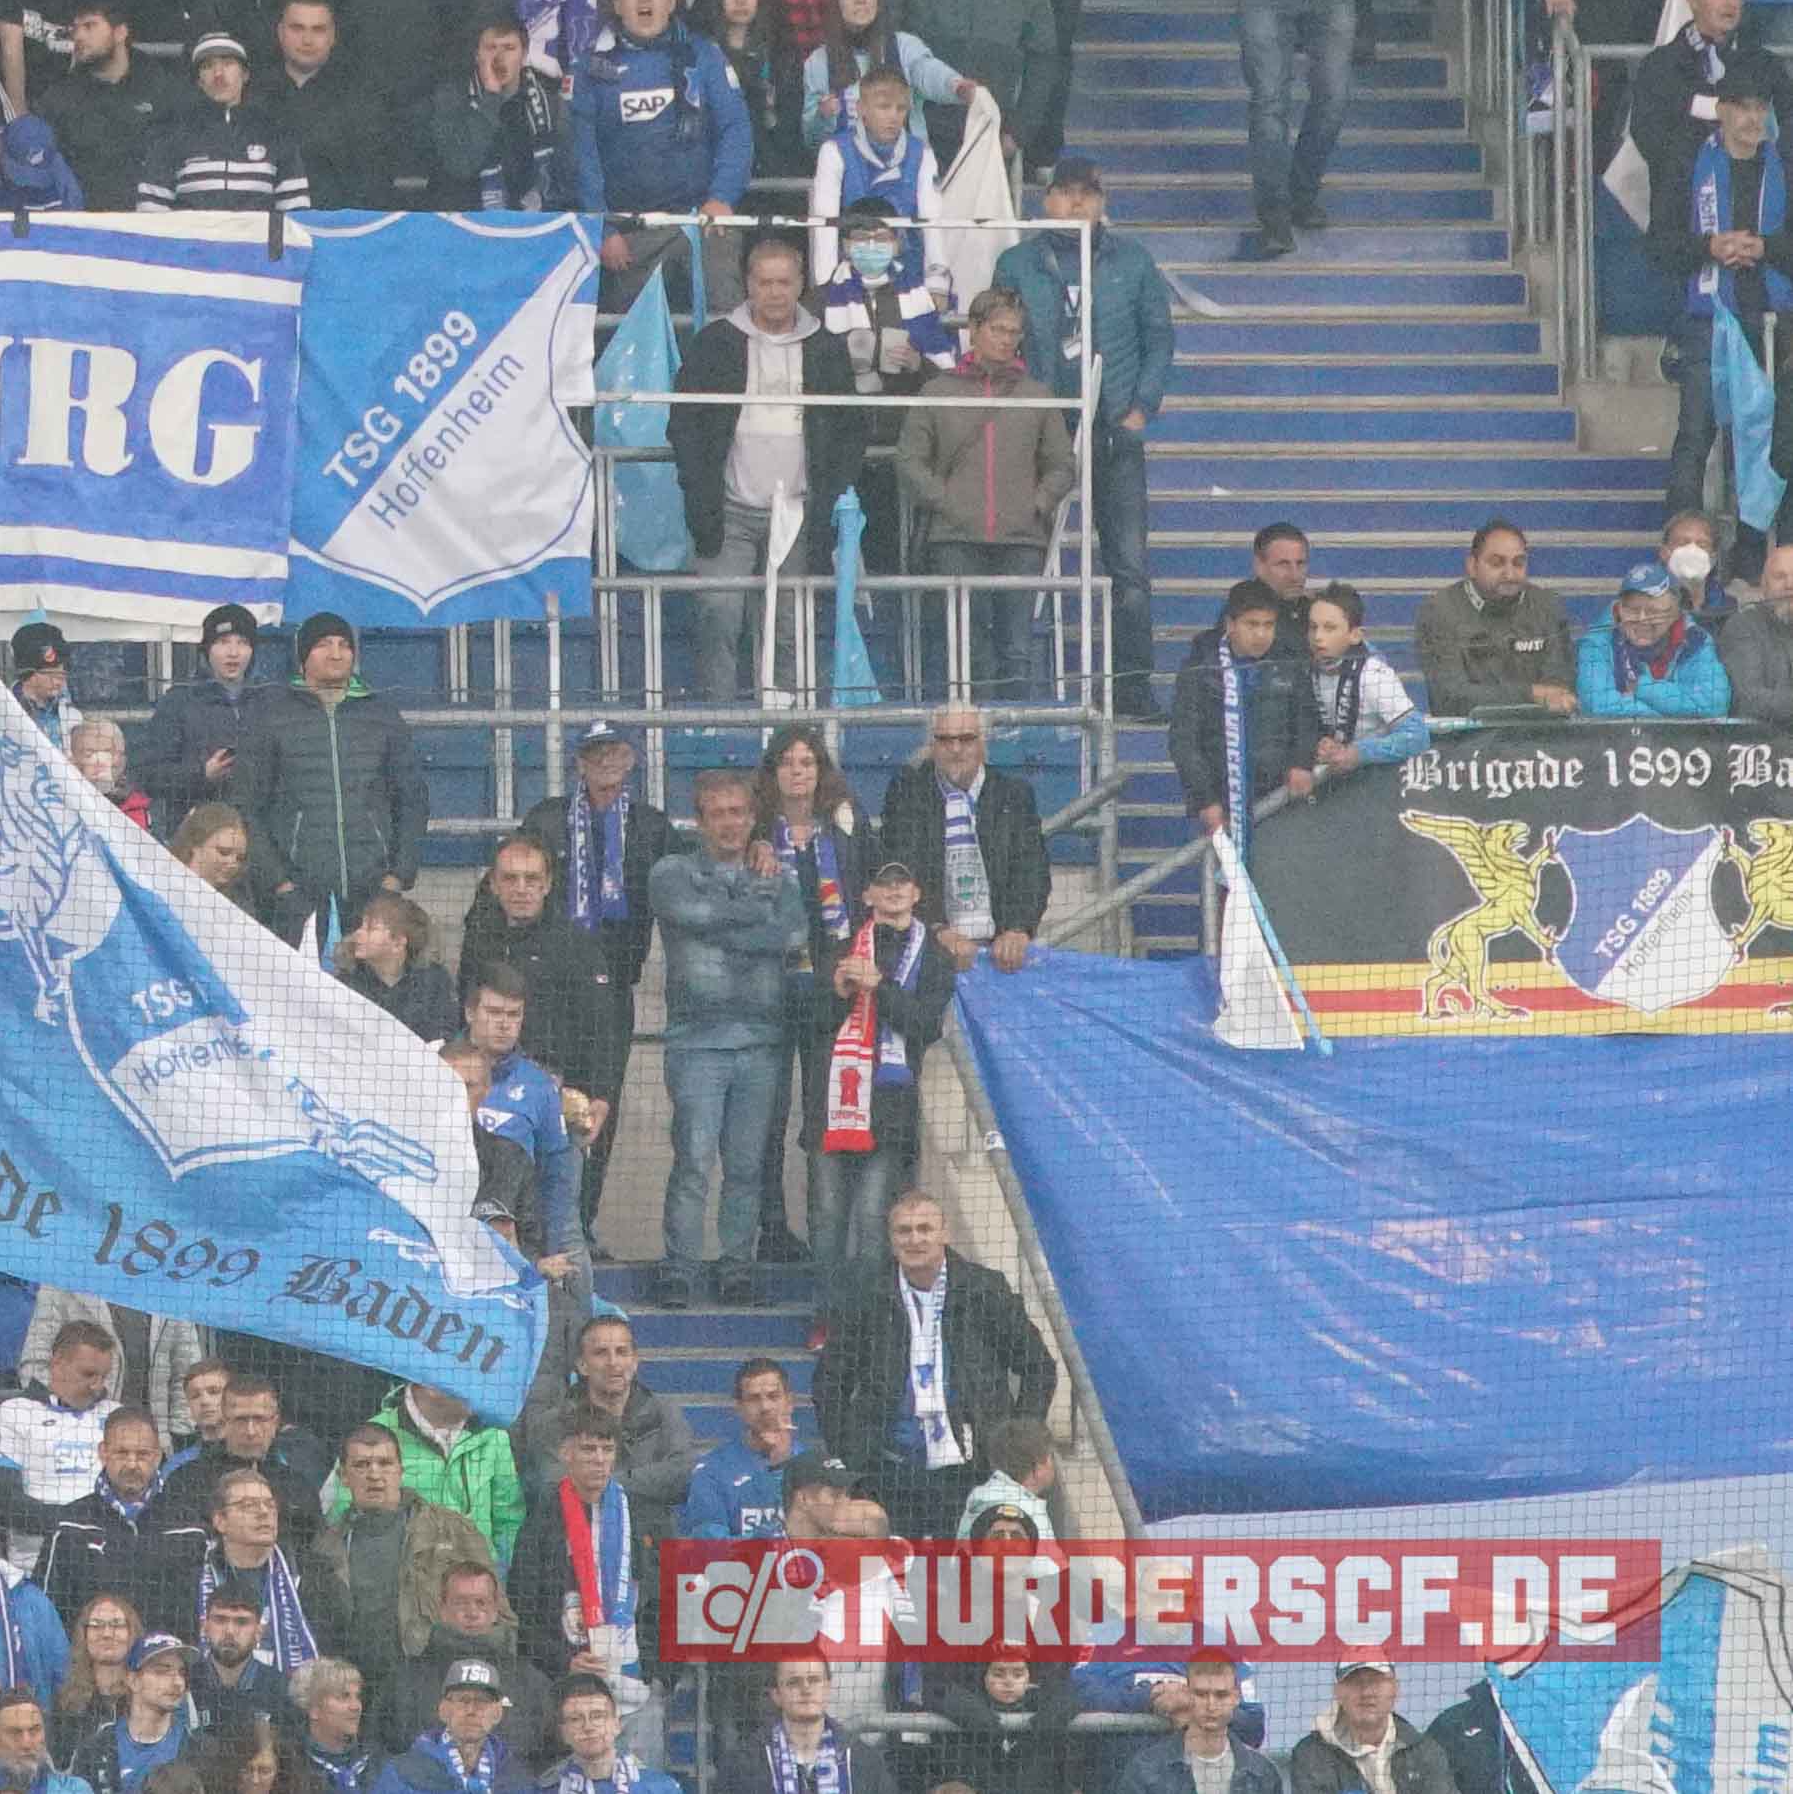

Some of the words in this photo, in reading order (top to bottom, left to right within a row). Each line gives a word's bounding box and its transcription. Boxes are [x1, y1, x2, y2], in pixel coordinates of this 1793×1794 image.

[622, 94, 668, 119] SAP
[322, 407, 404, 491] TSG
[392, 309, 480, 404] 1899
[368, 349, 524, 533] Hoffenheim
[1400, 748, 1584, 799] Brigade
[1606, 744, 1713, 789] 1899
[1595, 912, 1637, 961] TSG
[1633, 866, 1674, 919] 1899
[1621, 888, 1696, 978] Hoffenheim
[93, 1203, 262, 1291] 1899
[268, 1251, 511, 1376] Baden
